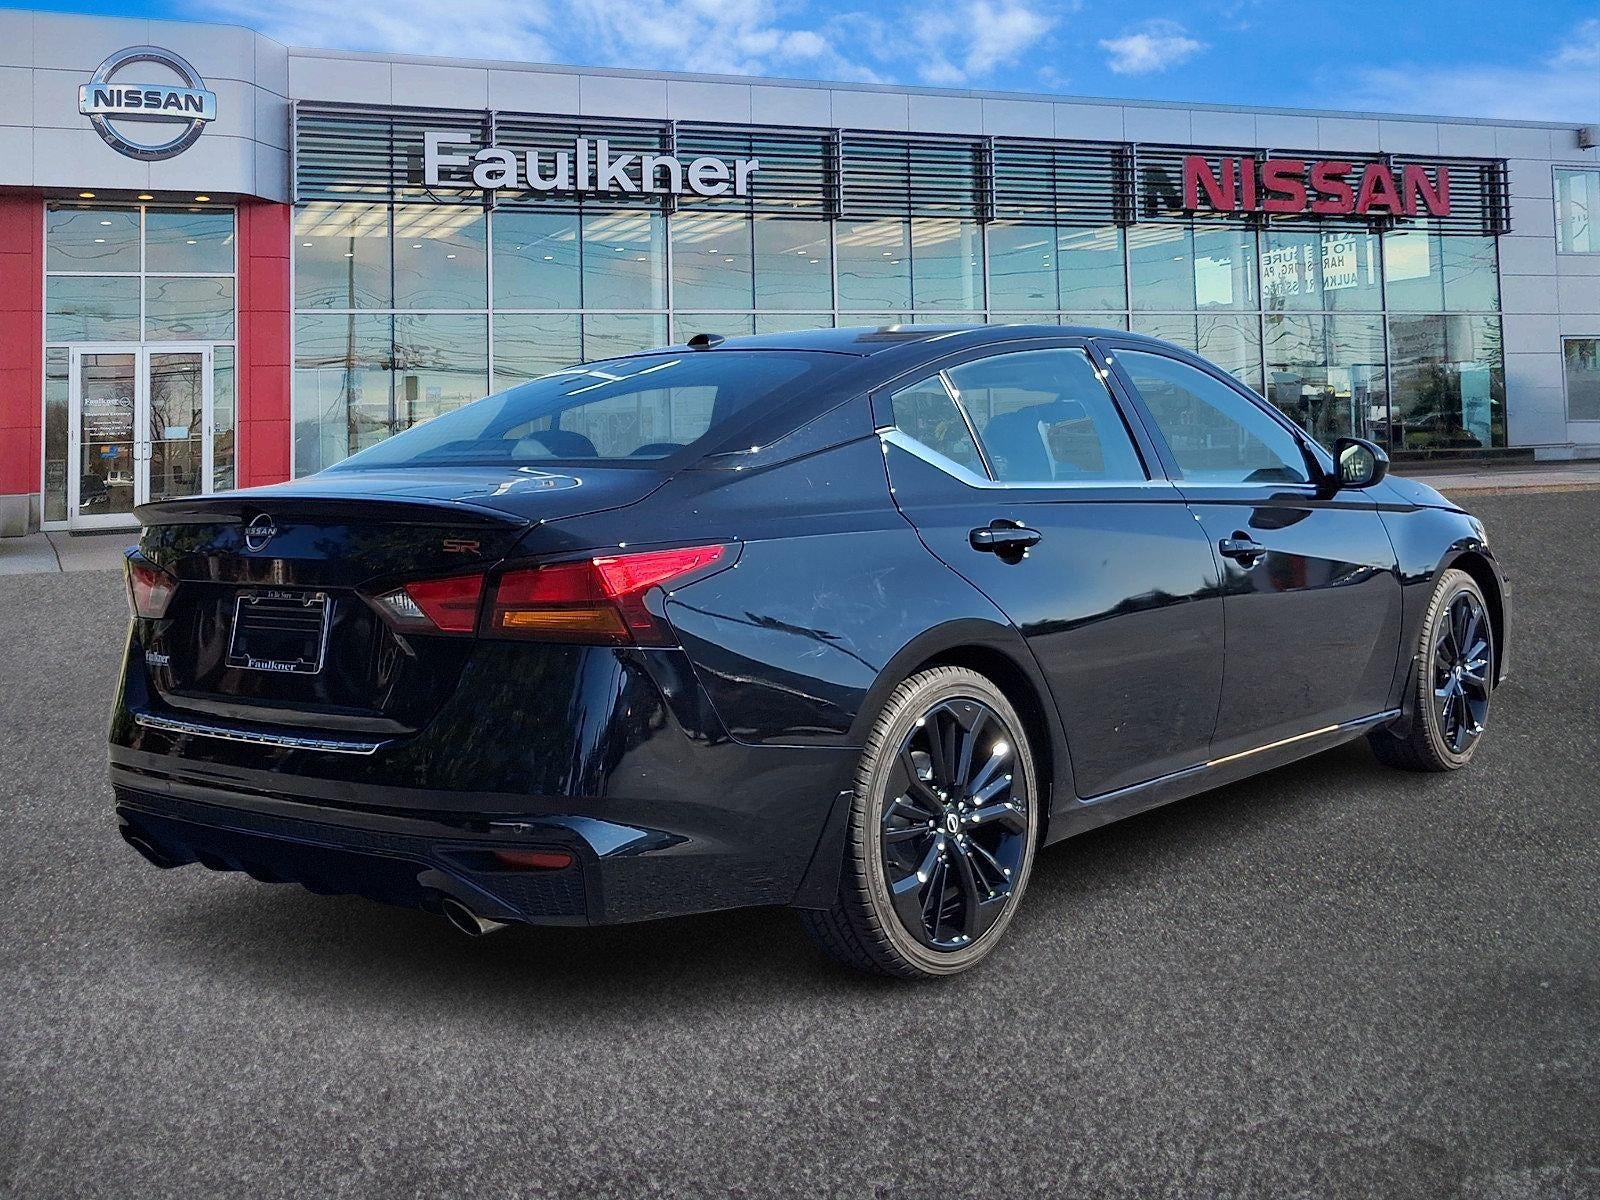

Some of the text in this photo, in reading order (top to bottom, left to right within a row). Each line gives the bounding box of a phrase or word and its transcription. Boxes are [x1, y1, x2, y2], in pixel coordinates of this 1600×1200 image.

[93, 89, 204, 113] NISSAN
[423, 131, 760, 196] Faulkner
[1182, 154, 1451, 217] NISSAN
[244, 527, 278, 536] NISSAN
[443, 539, 481, 556] SR
[248, 658, 297, 671] Faulkner
